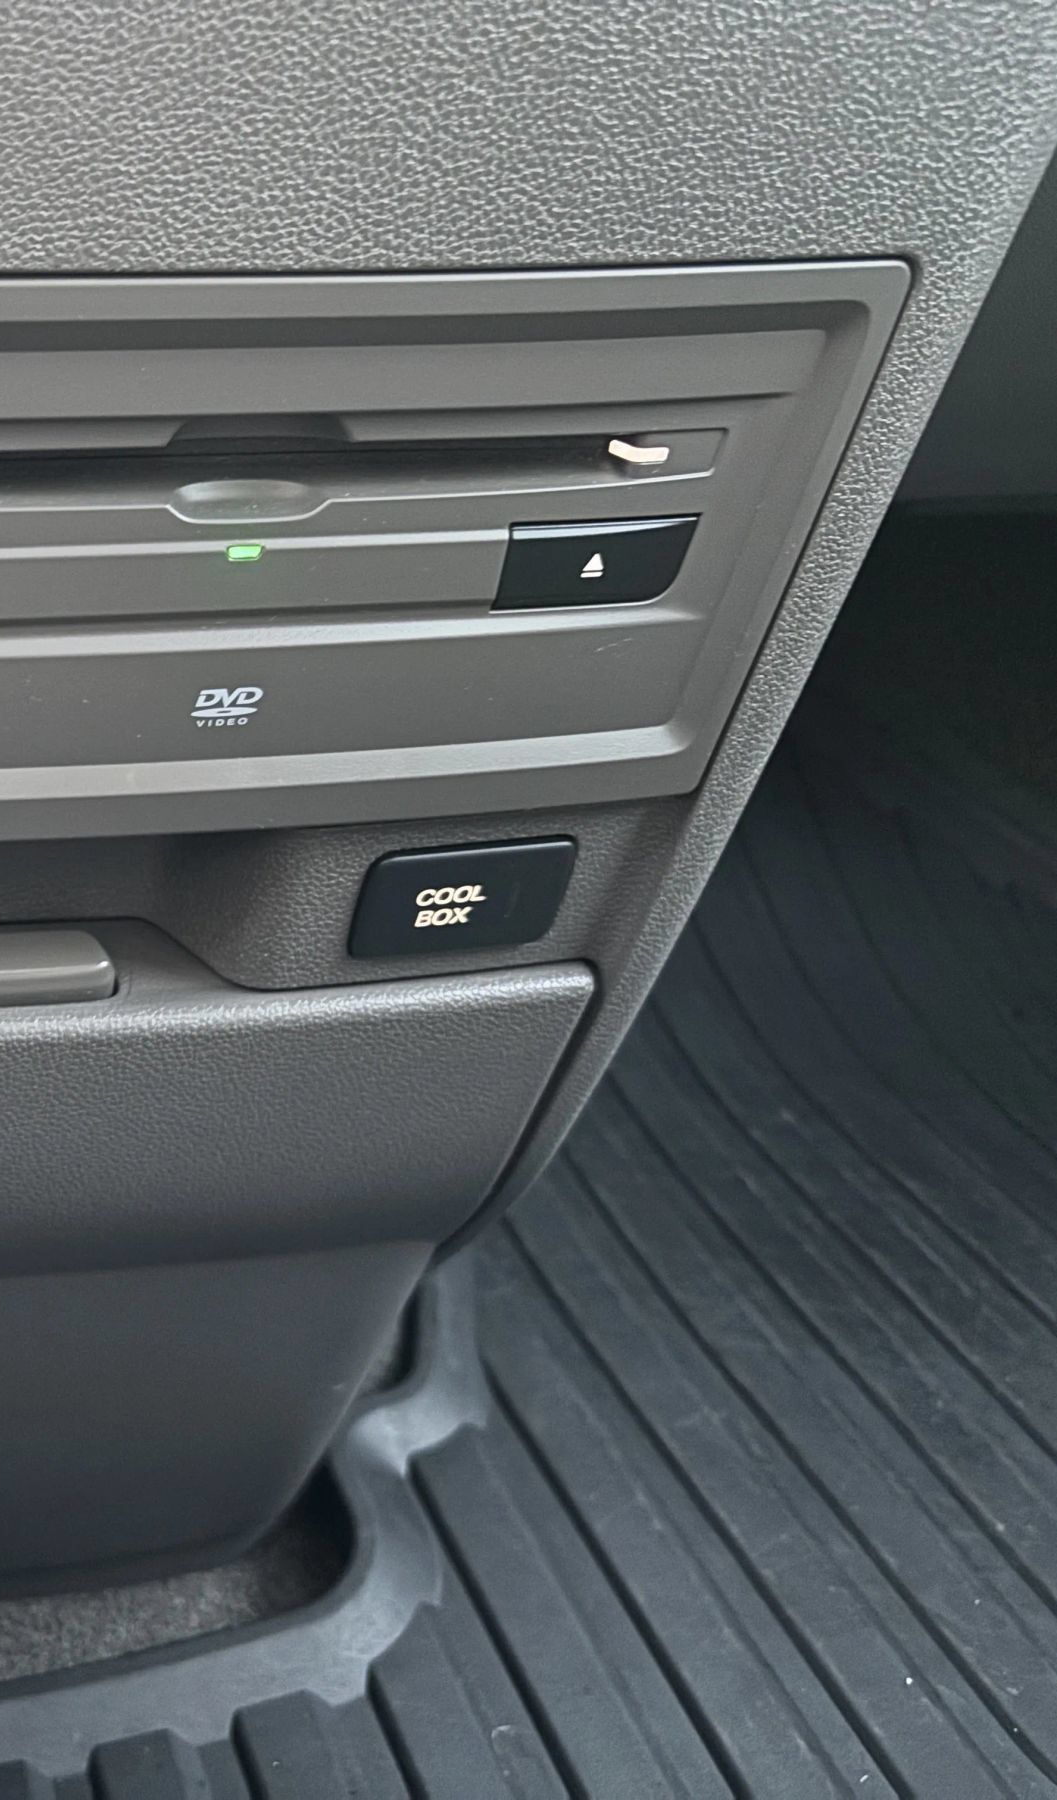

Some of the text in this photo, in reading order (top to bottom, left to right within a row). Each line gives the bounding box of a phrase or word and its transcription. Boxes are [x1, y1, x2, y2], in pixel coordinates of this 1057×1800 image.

[195, 686, 264, 708] DVD
[196, 717, 249, 728] VIDEO
[415, 884, 487, 907] COOL
[414, 906, 474, 928] BOX
